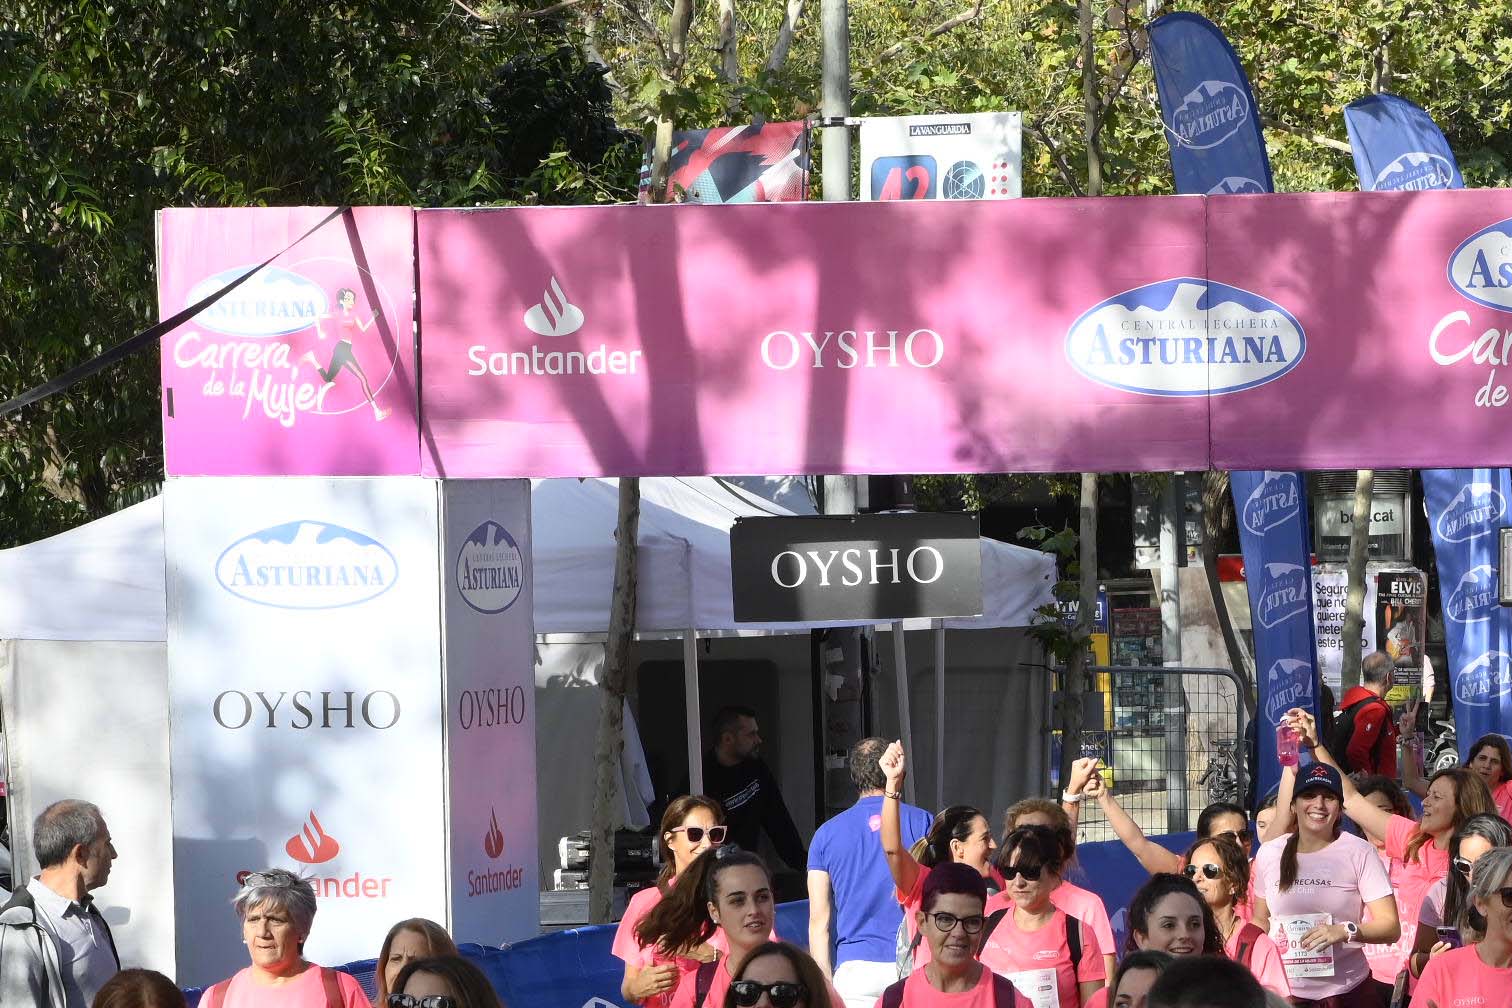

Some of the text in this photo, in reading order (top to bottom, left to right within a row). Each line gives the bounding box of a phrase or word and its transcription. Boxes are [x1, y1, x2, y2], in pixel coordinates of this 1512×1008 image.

[1121, 320, 1196, 331] CENTRAL
[174, 331, 291, 369] Carrera
[468, 344, 641, 376] Santander
[760, 329, 944, 369] OYSHO
[1087, 323, 1287, 365] ASTURIANA
[203, 367, 336, 427] de la Mujer
[1475, 369, 1509, 407] de
[230, 554, 385, 587] ASTURIANA
[461, 558, 520, 590] ASTURIANA
[771, 546, 944, 588] OYSHO
[1316, 599, 1332, 609] que
[1390, 581, 1421, 594] ELVIS
[1317, 637, 1337, 648] este
[213, 690, 401, 729] OYSHO
[460, 686, 525, 730] OYSHO
[468, 864, 523, 897] Santander
